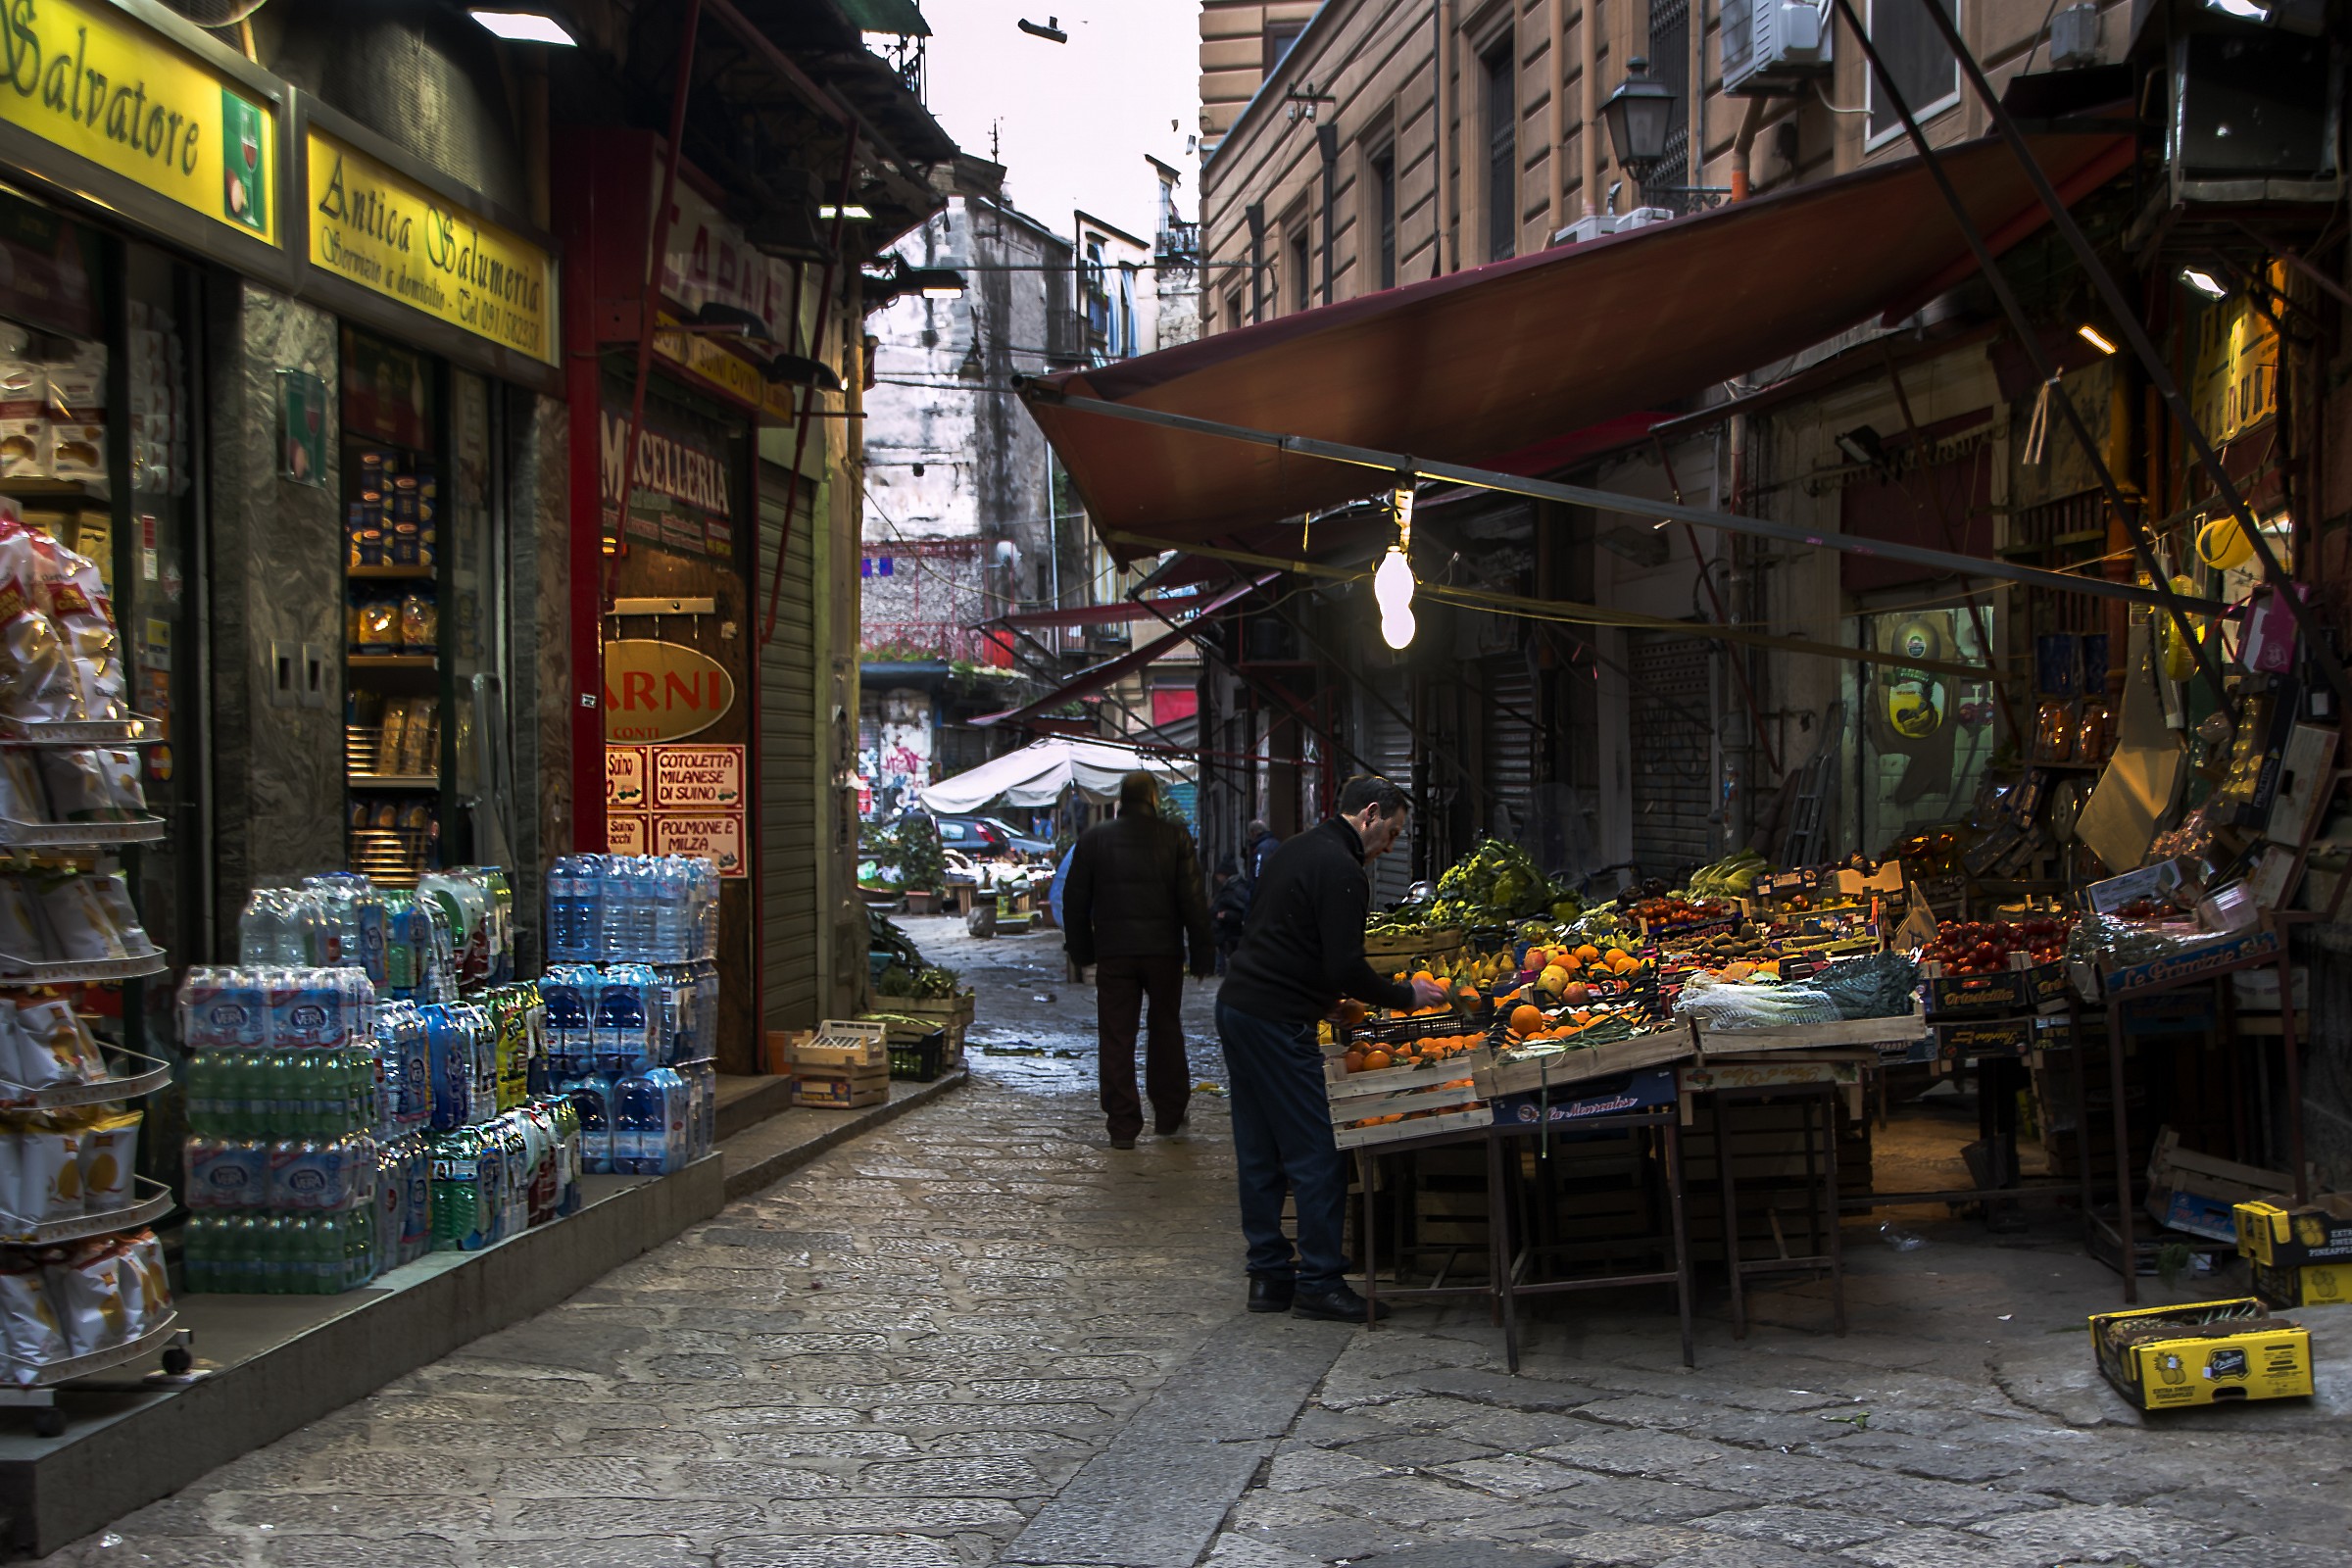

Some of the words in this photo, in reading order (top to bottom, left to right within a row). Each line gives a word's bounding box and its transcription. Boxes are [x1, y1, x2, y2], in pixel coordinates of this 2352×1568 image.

[0, 0, 199, 177] Salvatore
[318, 153, 412, 253] Antica
[426, 204, 540, 314] Salumeria
[320, 225, 382, 284] Servizio
[385, 267, 394, 289] a
[397, 264, 446, 312] domicilio
[612, 726, 660, 740] CONTI
[608, 754, 633, 776] Suino
[659, 754, 734, 768] COTOLETTA
[660, 769, 725, 785] MILANESE
[660, 787, 673, 800] DI
[675, 786, 716, 801] SUINO
[662, 820, 722, 836] POLMONE
[724, 821, 734, 835] E
[667, 838, 710, 852] MILZA
